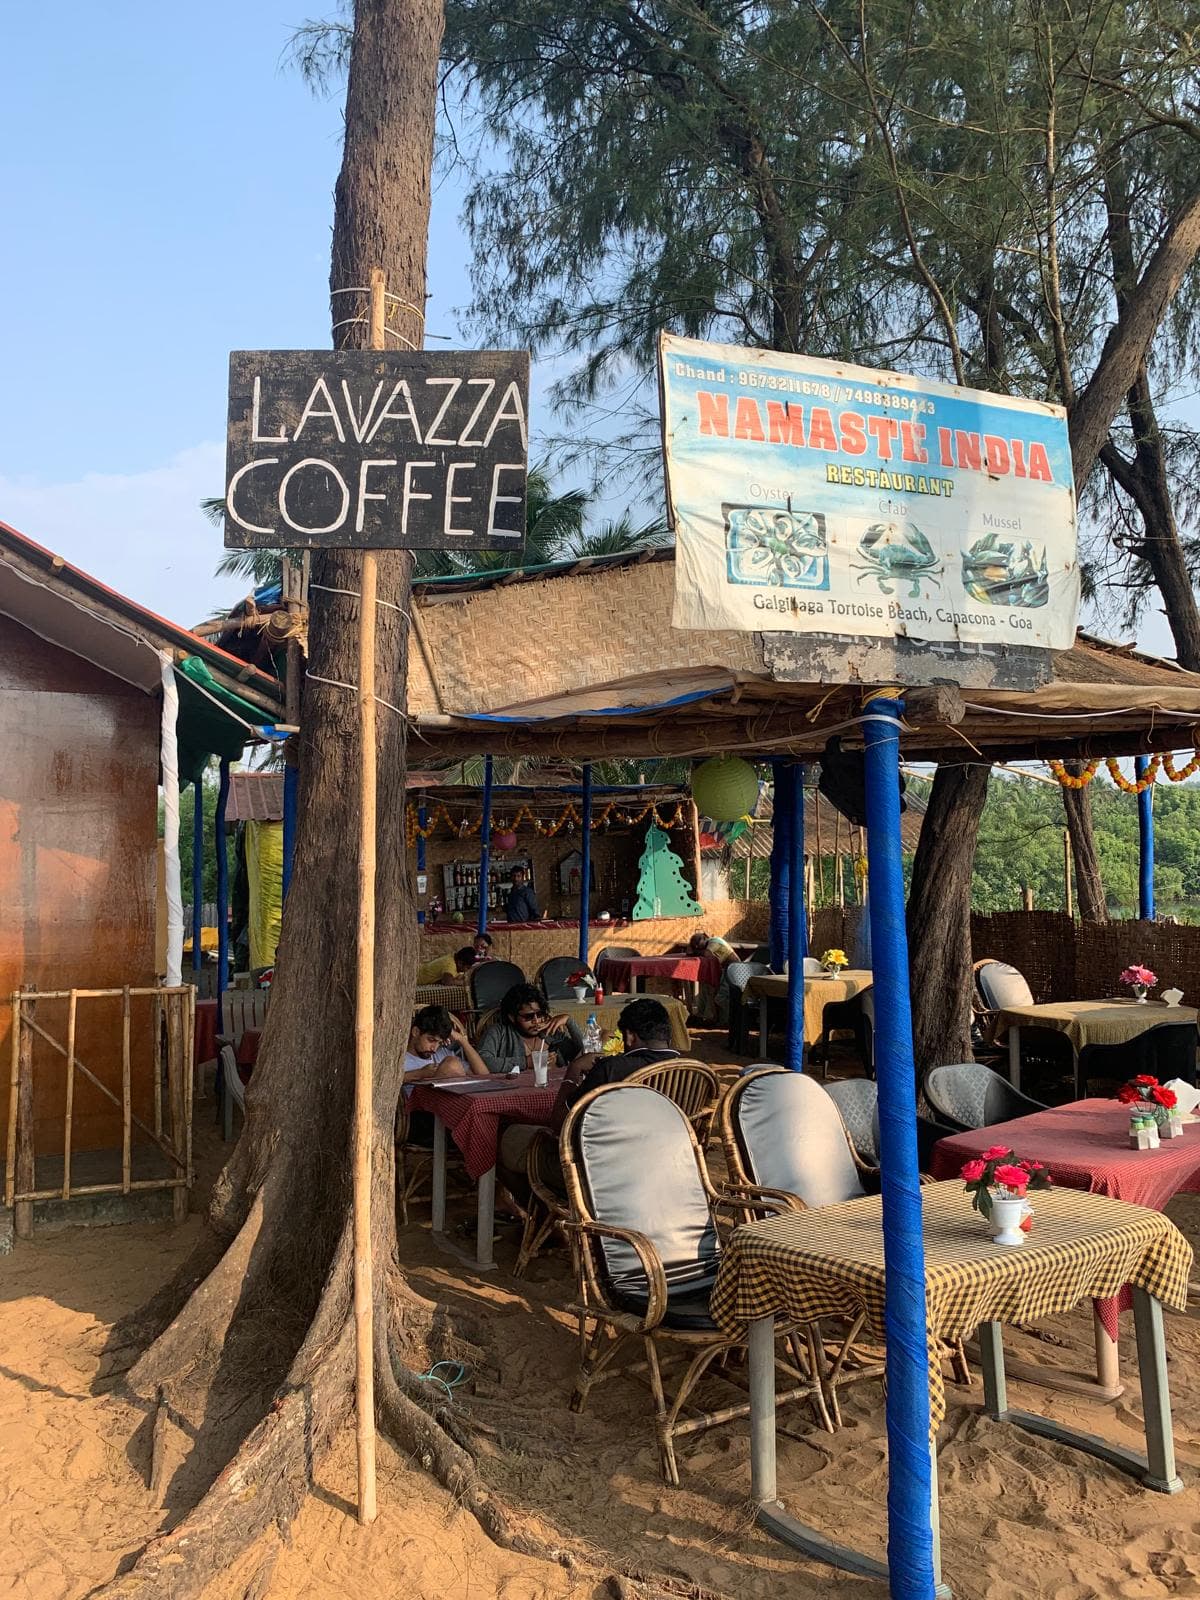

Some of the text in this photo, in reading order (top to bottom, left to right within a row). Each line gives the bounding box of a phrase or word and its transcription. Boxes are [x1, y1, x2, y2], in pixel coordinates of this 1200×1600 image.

[675, 362, 725, 383] Chand
[252, 376, 528, 450] LAVAZZA
[695, 391, 1053, 482] NAMASTE INDIA
[749, 483, 795, 500] Oyster
[826, 463, 954, 498] RESTAURANT
[227, 458, 525, 537] COFFEE
[879, 500, 907, 516] Crab
[983, 513, 1022, 530] Mussel
[828, 600, 883, 618] Tortoise
[888, 603, 932, 623] Beach,
[936, 608, 996, 626] Canacona
[1009, 614, 1033, 630] Goa
